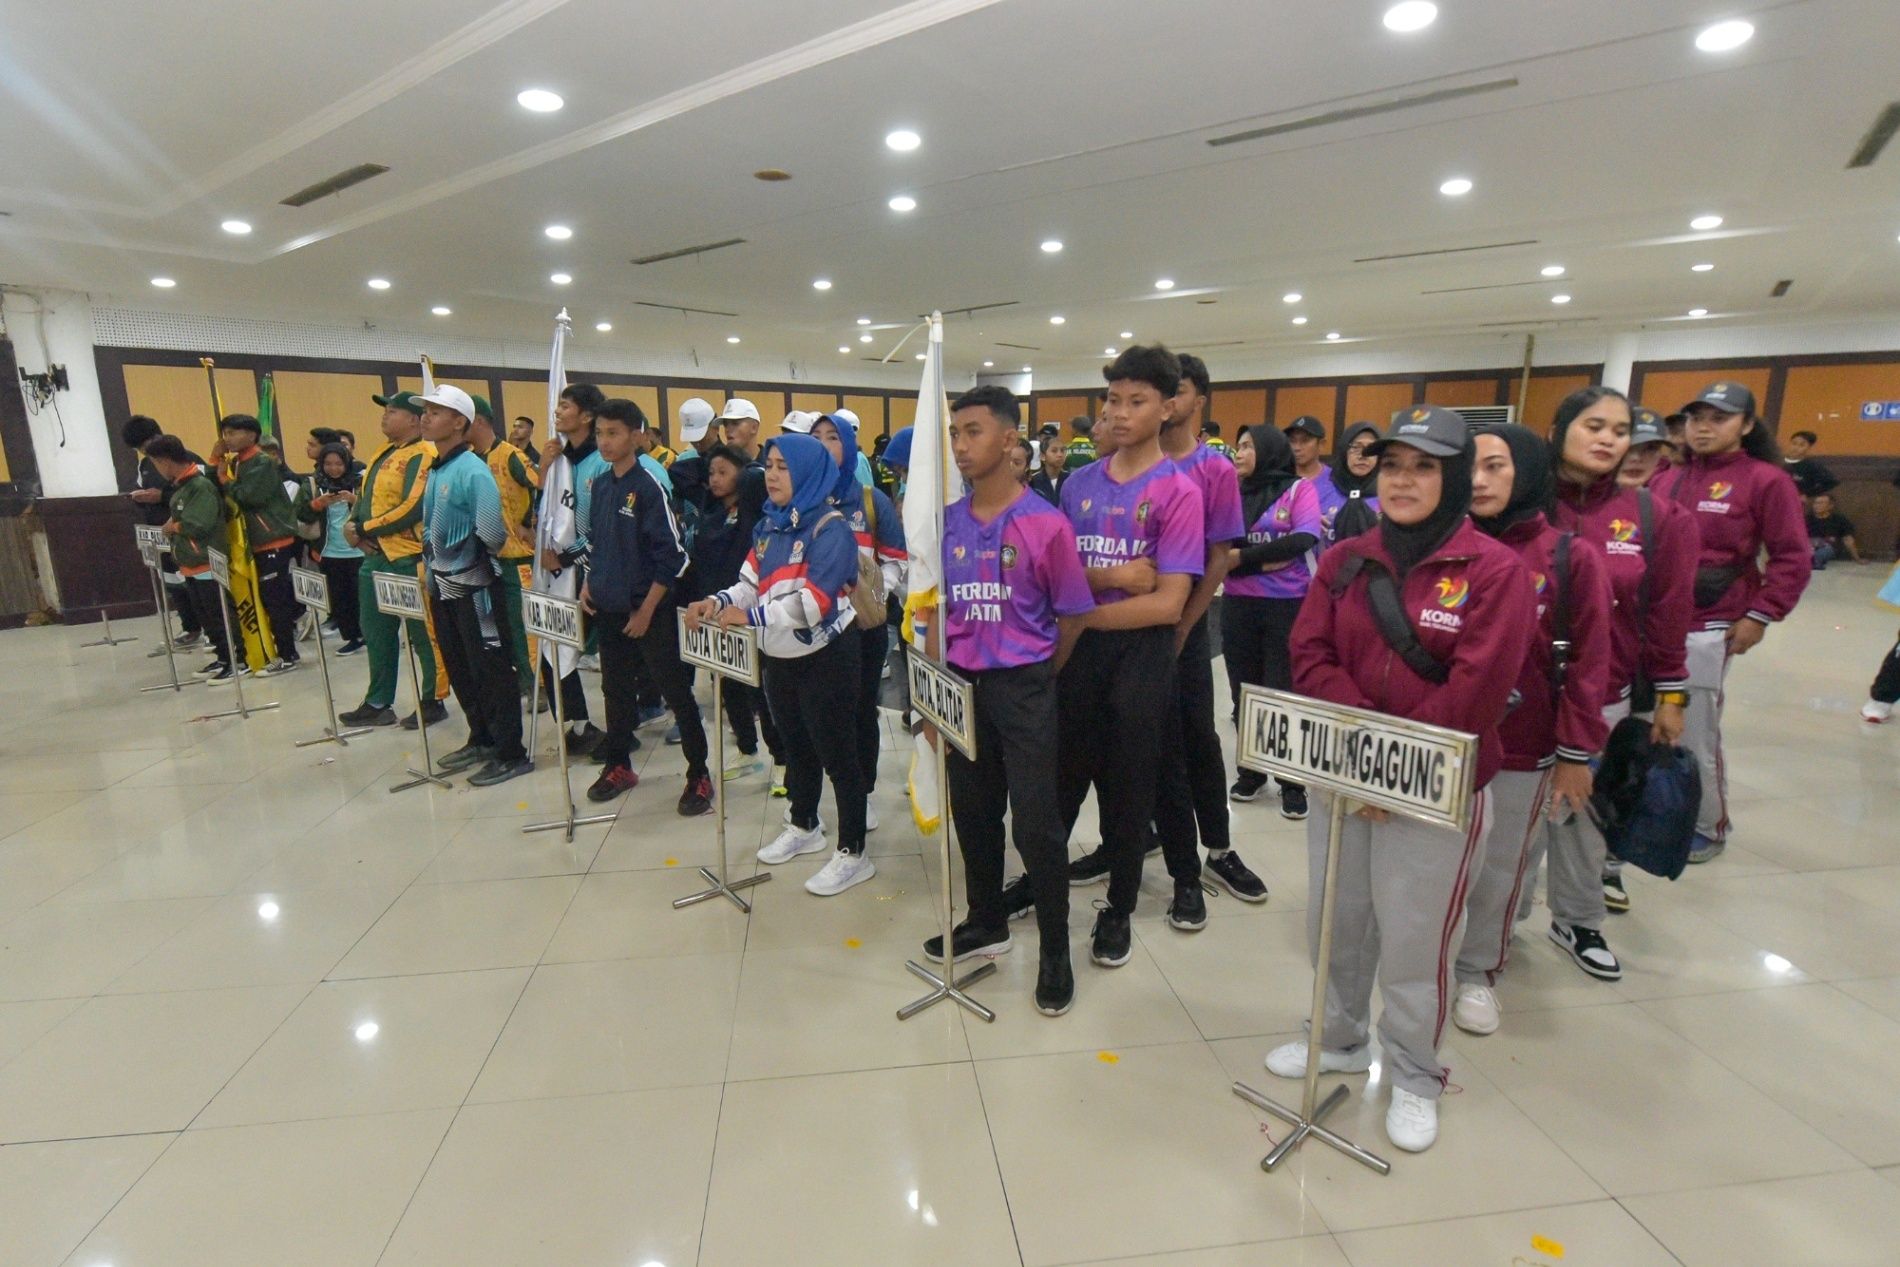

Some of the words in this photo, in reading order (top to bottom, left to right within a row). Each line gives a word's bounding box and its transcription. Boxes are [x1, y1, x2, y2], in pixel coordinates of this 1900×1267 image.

[544, 604, 577, 638] JOMBANG
[685, 627, 711, 659] KOTA
[713, 630, 749, 671] KEDIRI
[936, 679, 966, 737] BLITAR
[1255, 708, 1292, 761] KAB.
[1300, 719, 1445, 802] TULUNGAGUNG
